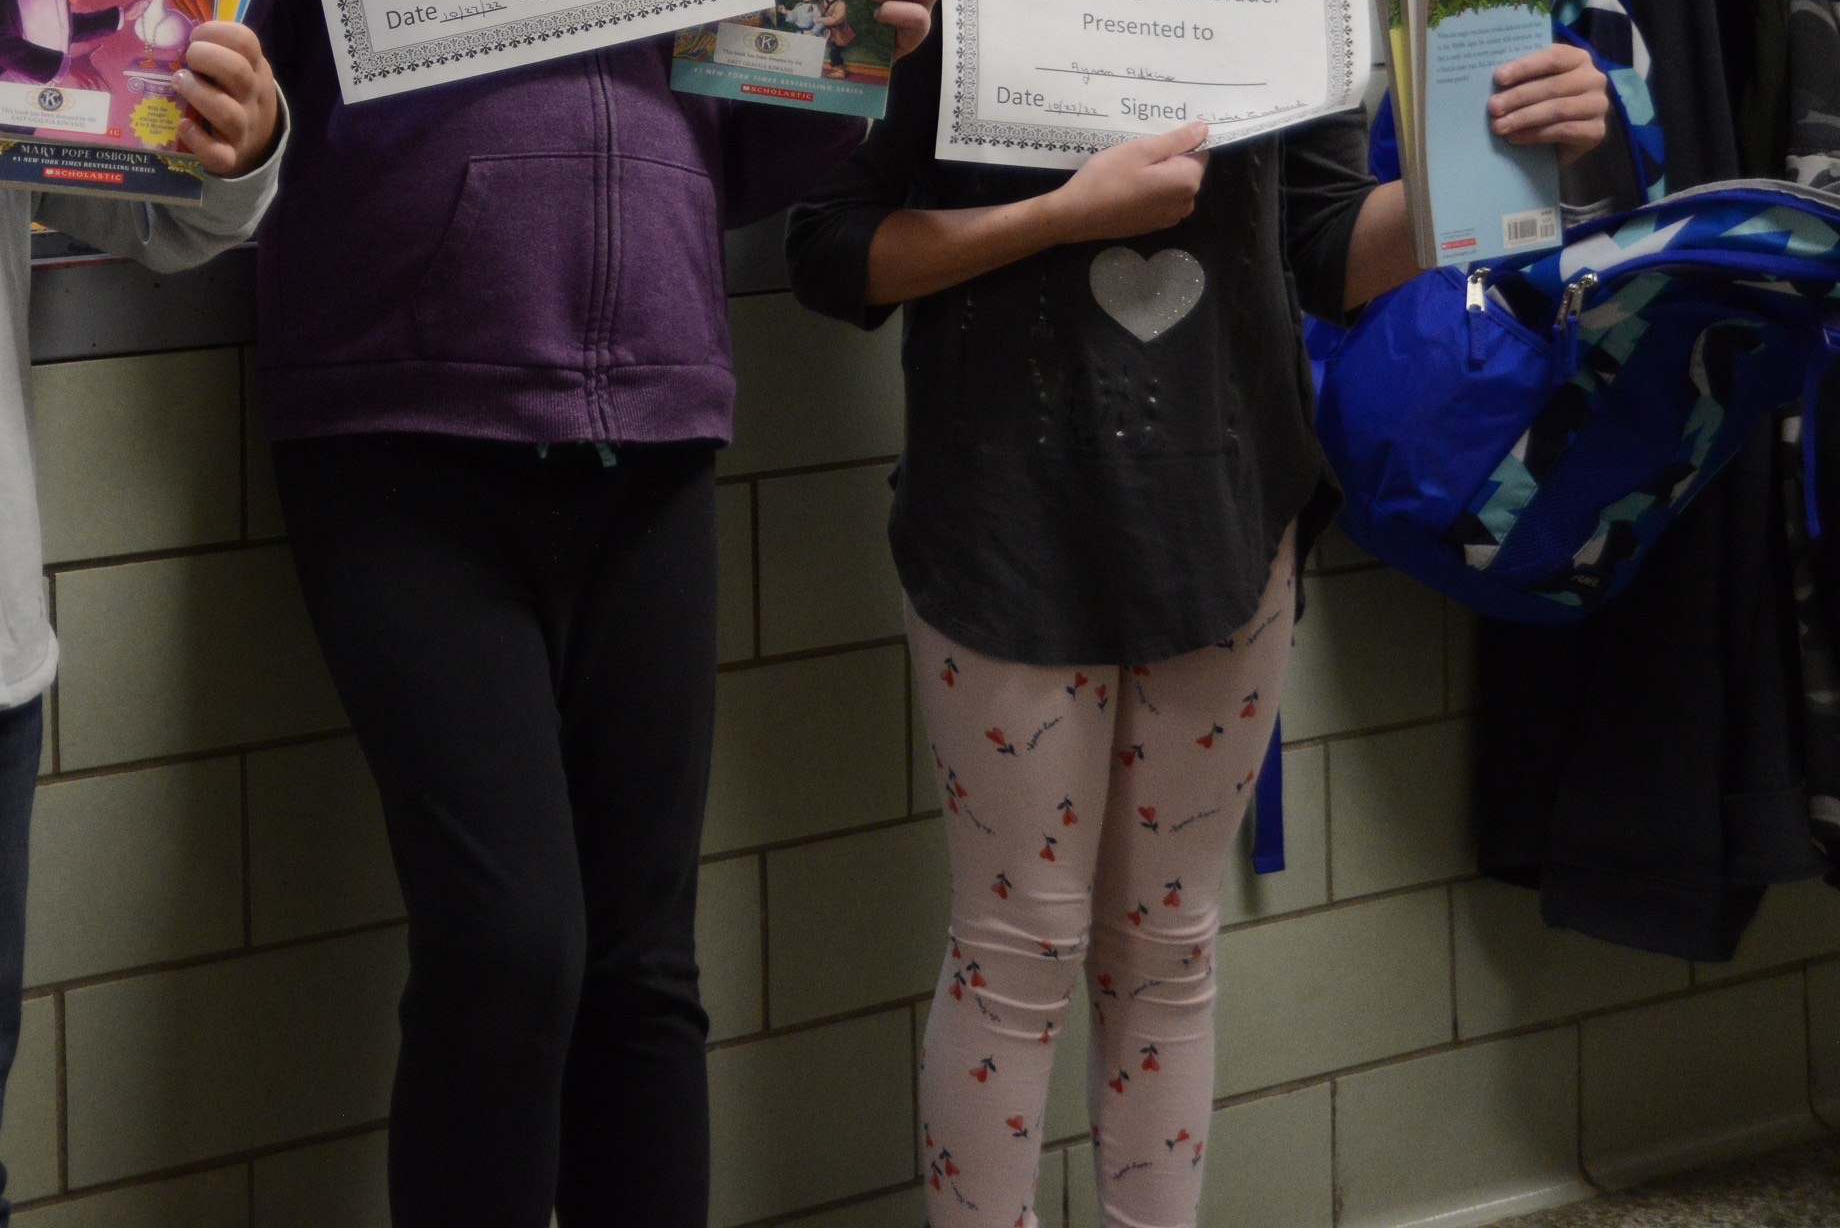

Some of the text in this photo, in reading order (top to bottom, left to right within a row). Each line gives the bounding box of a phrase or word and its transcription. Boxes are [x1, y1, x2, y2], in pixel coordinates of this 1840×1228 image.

[385, 1, 438, 30] Date
[1083, 13, 1214, 41] Presented to
[750, 84, 813, 101] SCHOLASTIC
[997, 86, 1044, 109] Date
[1120, 96, 1187, 121] Signed
[20, 145, 151, 165] MARY POPE OSBORNE
[54, 169, 122, 182] SCHOLASTIC
